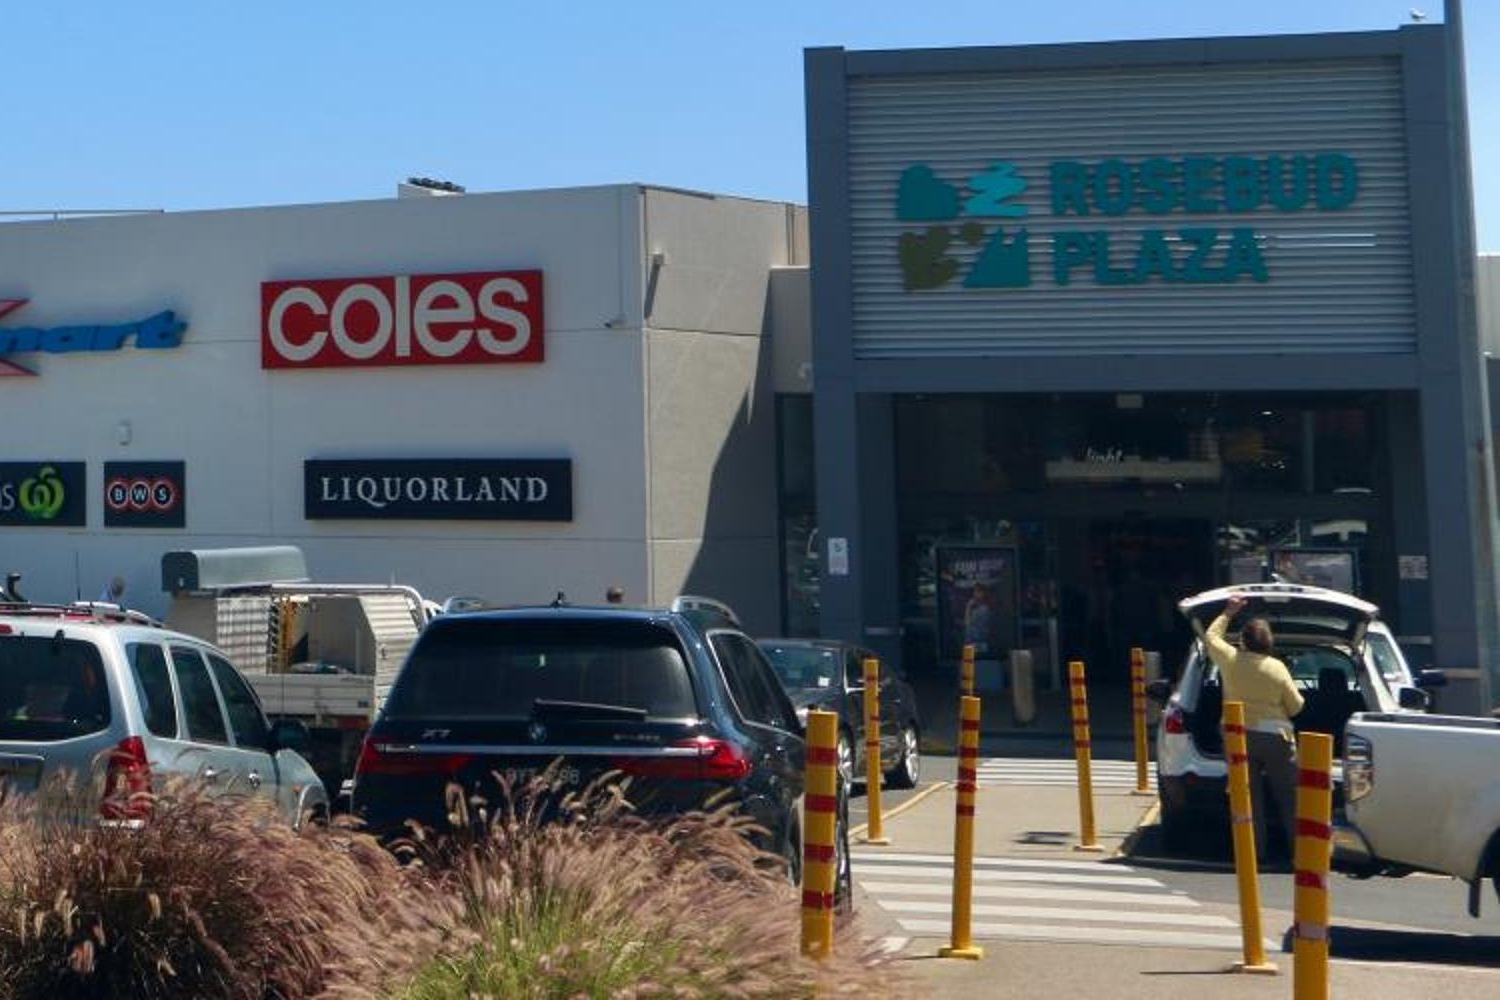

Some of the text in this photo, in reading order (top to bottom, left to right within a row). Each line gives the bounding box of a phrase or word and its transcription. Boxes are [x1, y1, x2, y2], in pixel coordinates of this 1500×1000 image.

[1050, 152, 1359, 217] ROSEBUD
[1053, 227, 1269, 286] PLAZA
[268, 275, 532, 362] coles
[321, 476, 548, 508] LIQUORLAND
